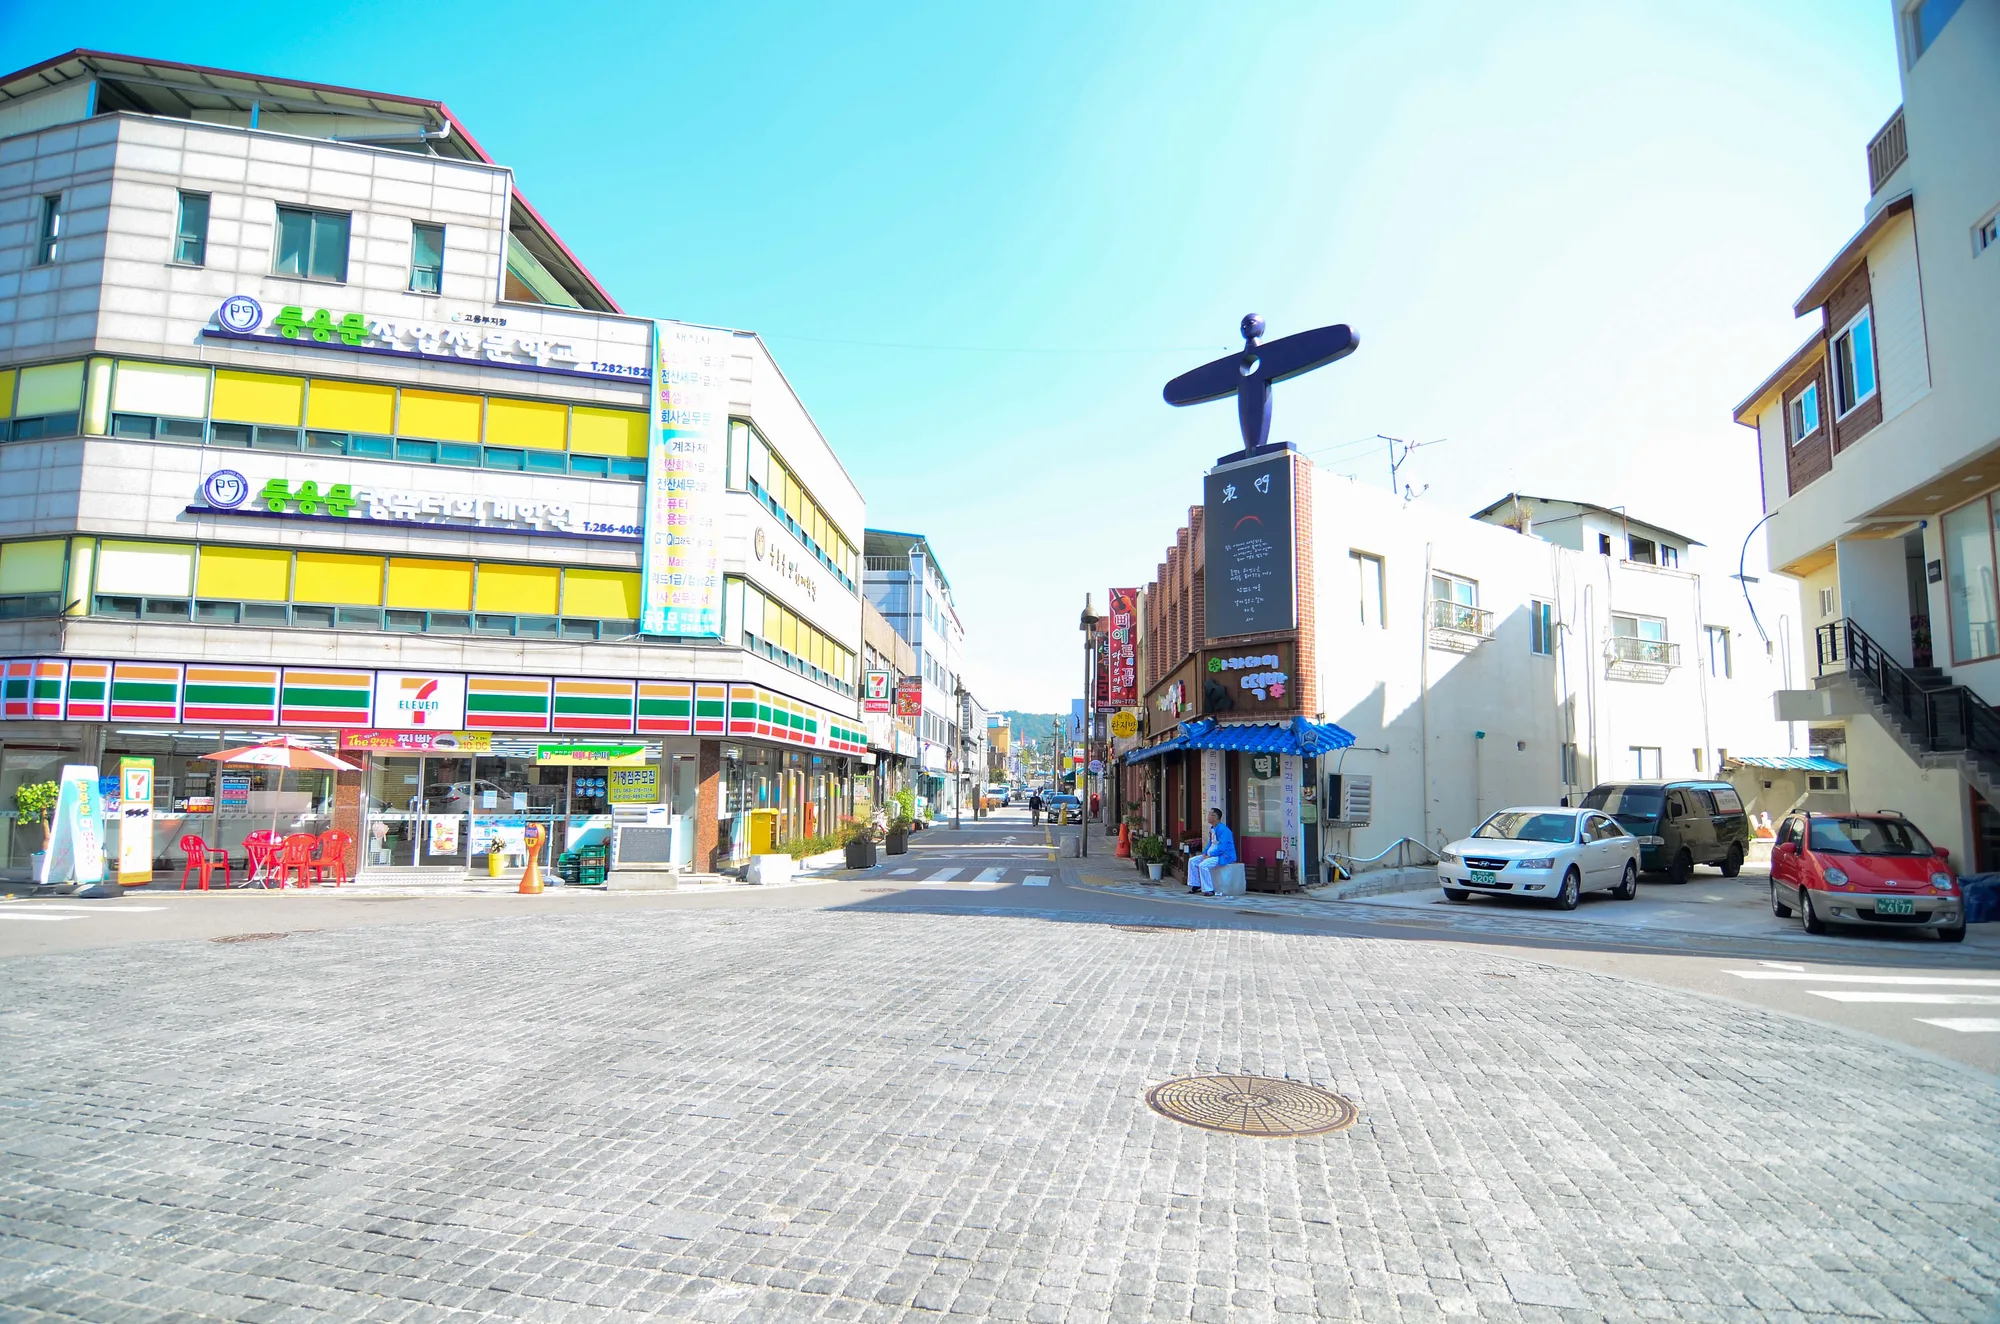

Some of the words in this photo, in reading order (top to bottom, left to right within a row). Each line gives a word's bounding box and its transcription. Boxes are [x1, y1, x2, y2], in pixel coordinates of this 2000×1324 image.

[274, 305, 369, 346] 등용문
[260, 478, 357, 517] 등용문
[347, 733, 368, 747] The
[1471, 874, 1495, 885] 8209
